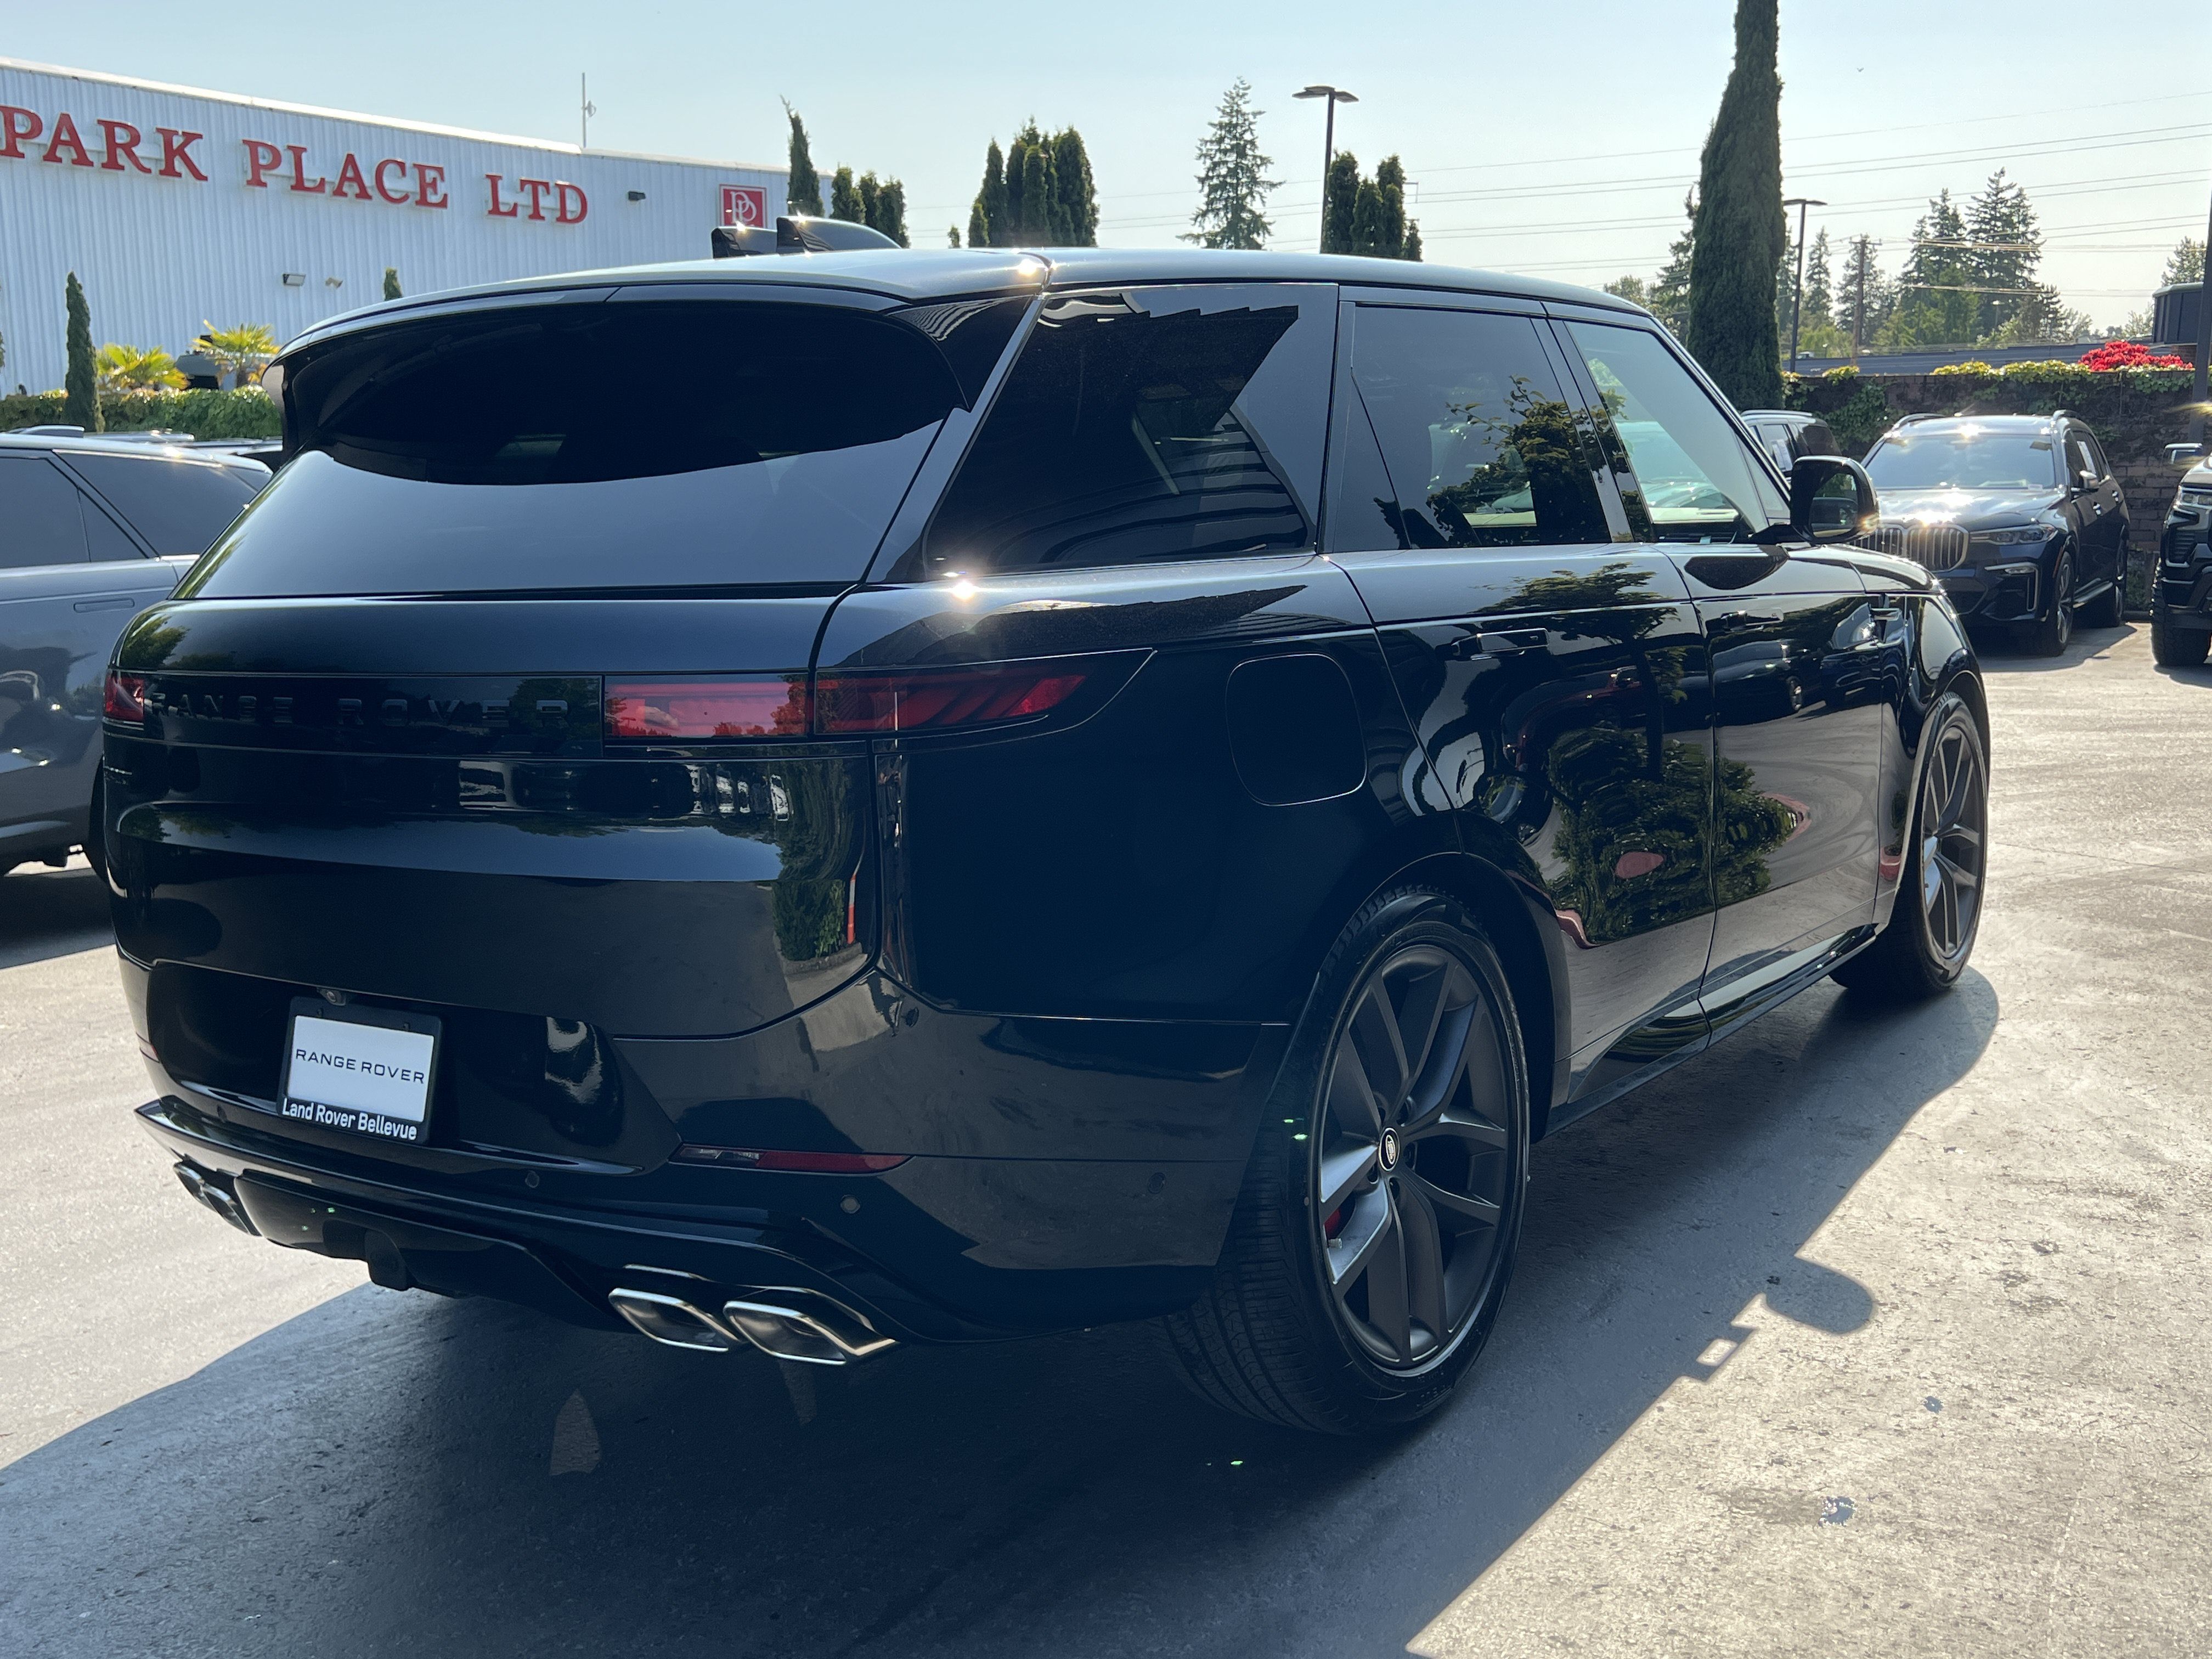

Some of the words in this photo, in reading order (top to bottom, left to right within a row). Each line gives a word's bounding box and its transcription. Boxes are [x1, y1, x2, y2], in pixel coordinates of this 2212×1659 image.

[0, 104, 208, 182] PARK
[241, 139, 448, 209] PLACE
[485, 173, 588, 224] LTD
[149, 692, 294, 724] RANGE
[337, 698, 569, 727] ROVER
[295, 1048, 356, 1070] RANGE
[361, 1061, 425, 1084] ROVER
[281, 1097, 314, 1121] Land
[315, 1104, 356, 1128] Rover
[357, 1112, 417, 1141] Bellevue
